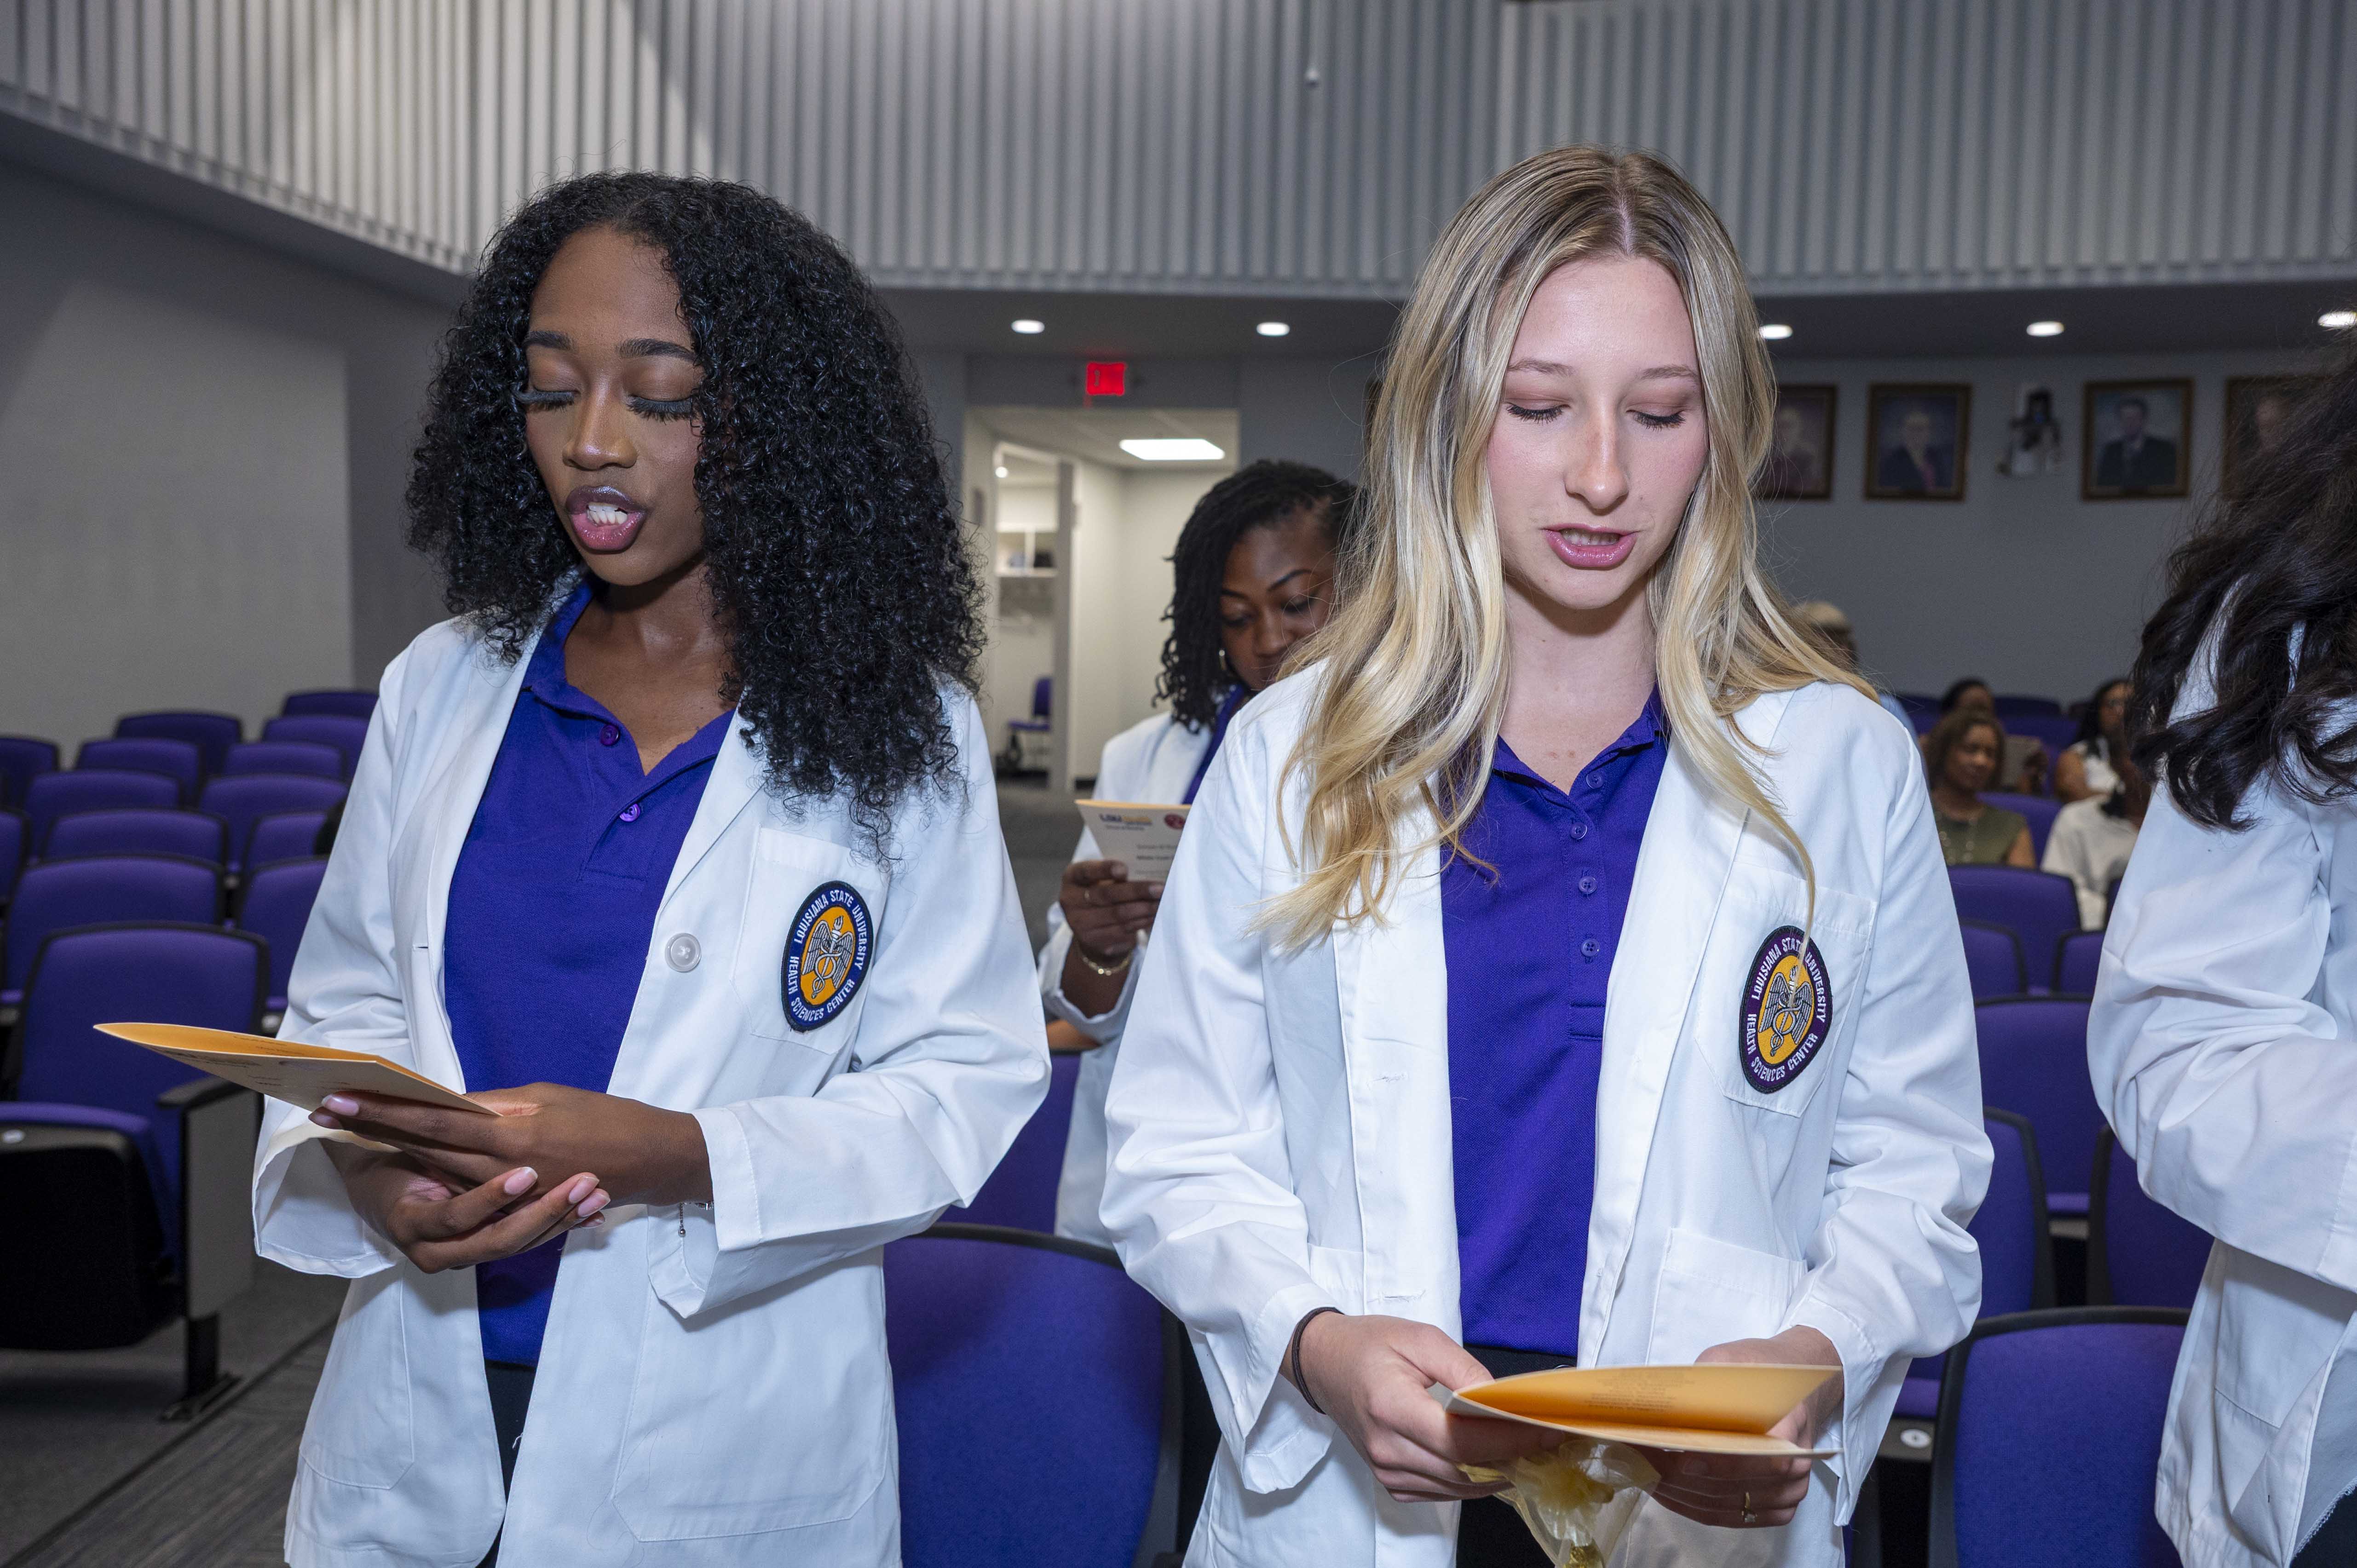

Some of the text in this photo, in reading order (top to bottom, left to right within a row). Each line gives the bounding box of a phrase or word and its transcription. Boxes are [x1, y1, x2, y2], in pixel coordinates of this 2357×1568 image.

[794, 890, 867, 971] LOUISIANA STATE UNIVERSITY
[788, 956, 855, 1022] HEALTH SCIENCES CENTER
[1752, 937, 1826, 1023] LOUISIANA STAT UNIVERSITY
[1746, 1014, 1818, 1082] HEALTH SCIENCES CENTER
